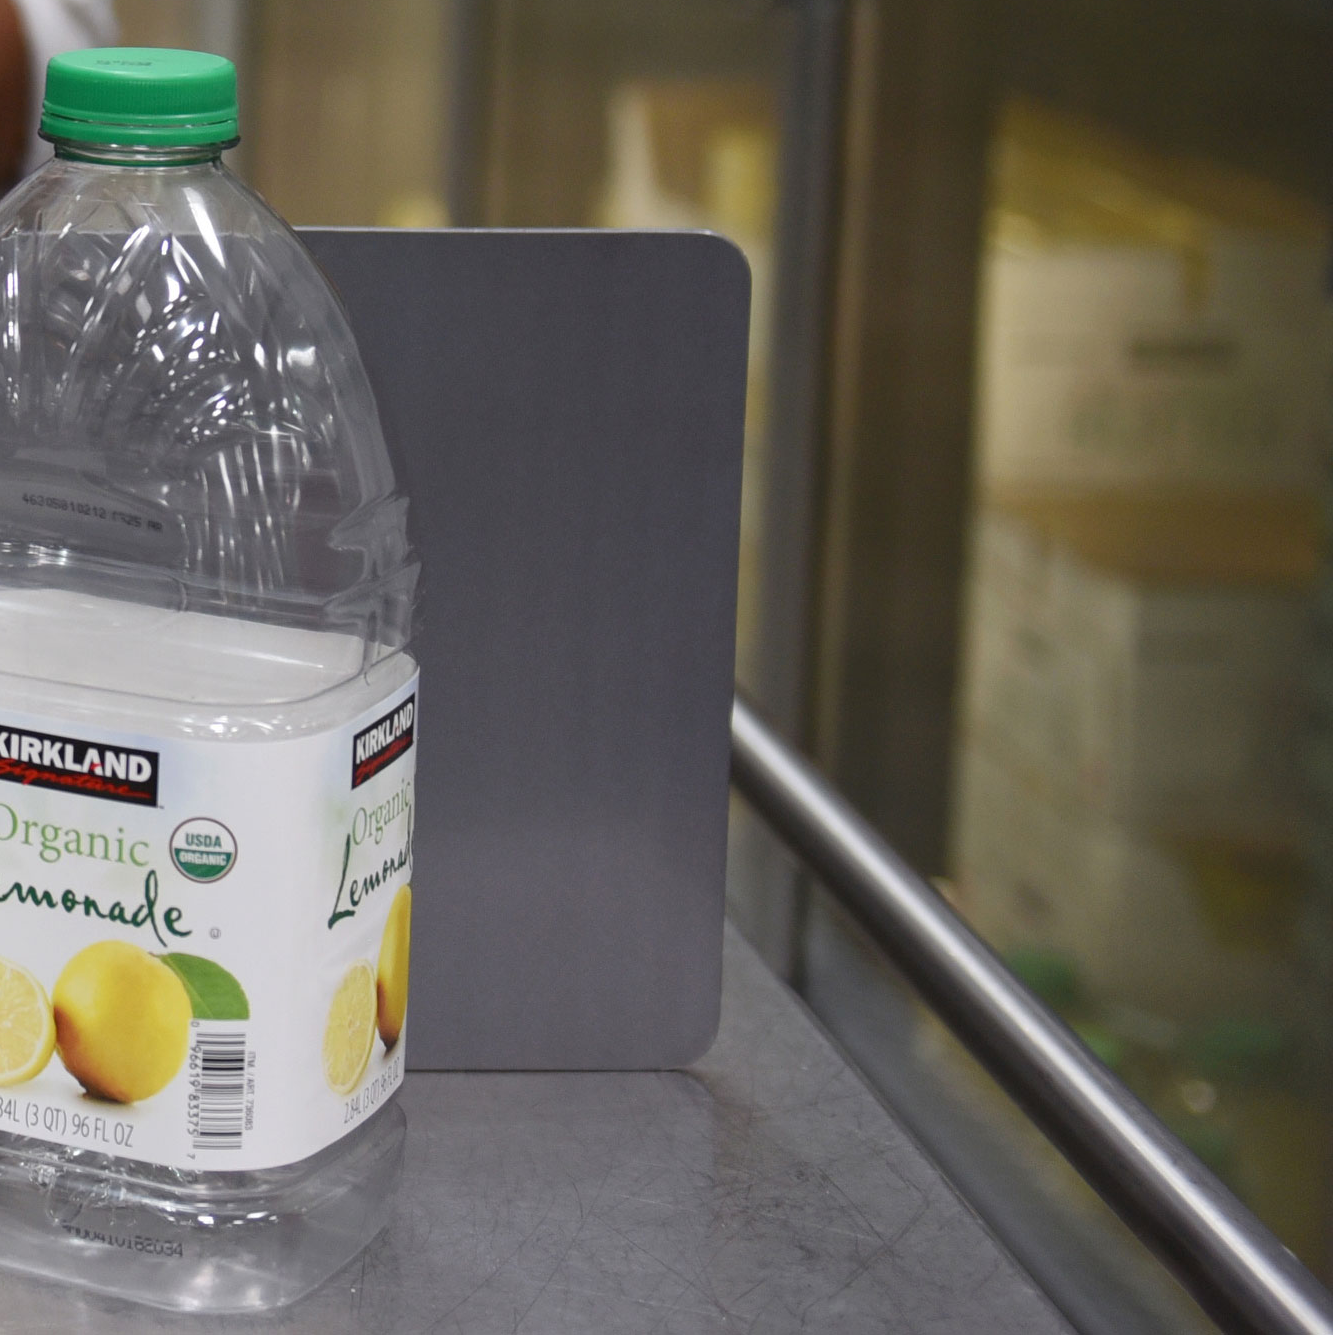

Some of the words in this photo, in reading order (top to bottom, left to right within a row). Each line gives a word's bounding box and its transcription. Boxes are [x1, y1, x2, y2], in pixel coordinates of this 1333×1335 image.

[356, 702, 414, 764] KIRKLAND
[352, 778, 411, 846] Organic
[178, 852, 227, 866] ORGANIC
[185, 832, 222, 850] USDA
[327, 804, 413, 930] Lemonad
[189, 1045, 202, 1089] 96619
[25, 1101, 39, 1128] (3
[43, 1106, 67, 1136] QT)
[72, 1113, 90, 1138] 96
[94, 1117, 110, 1143] FL
[114, 1122, 134, 1148] OZ
[187, 1094, 200, 1137] 83375
